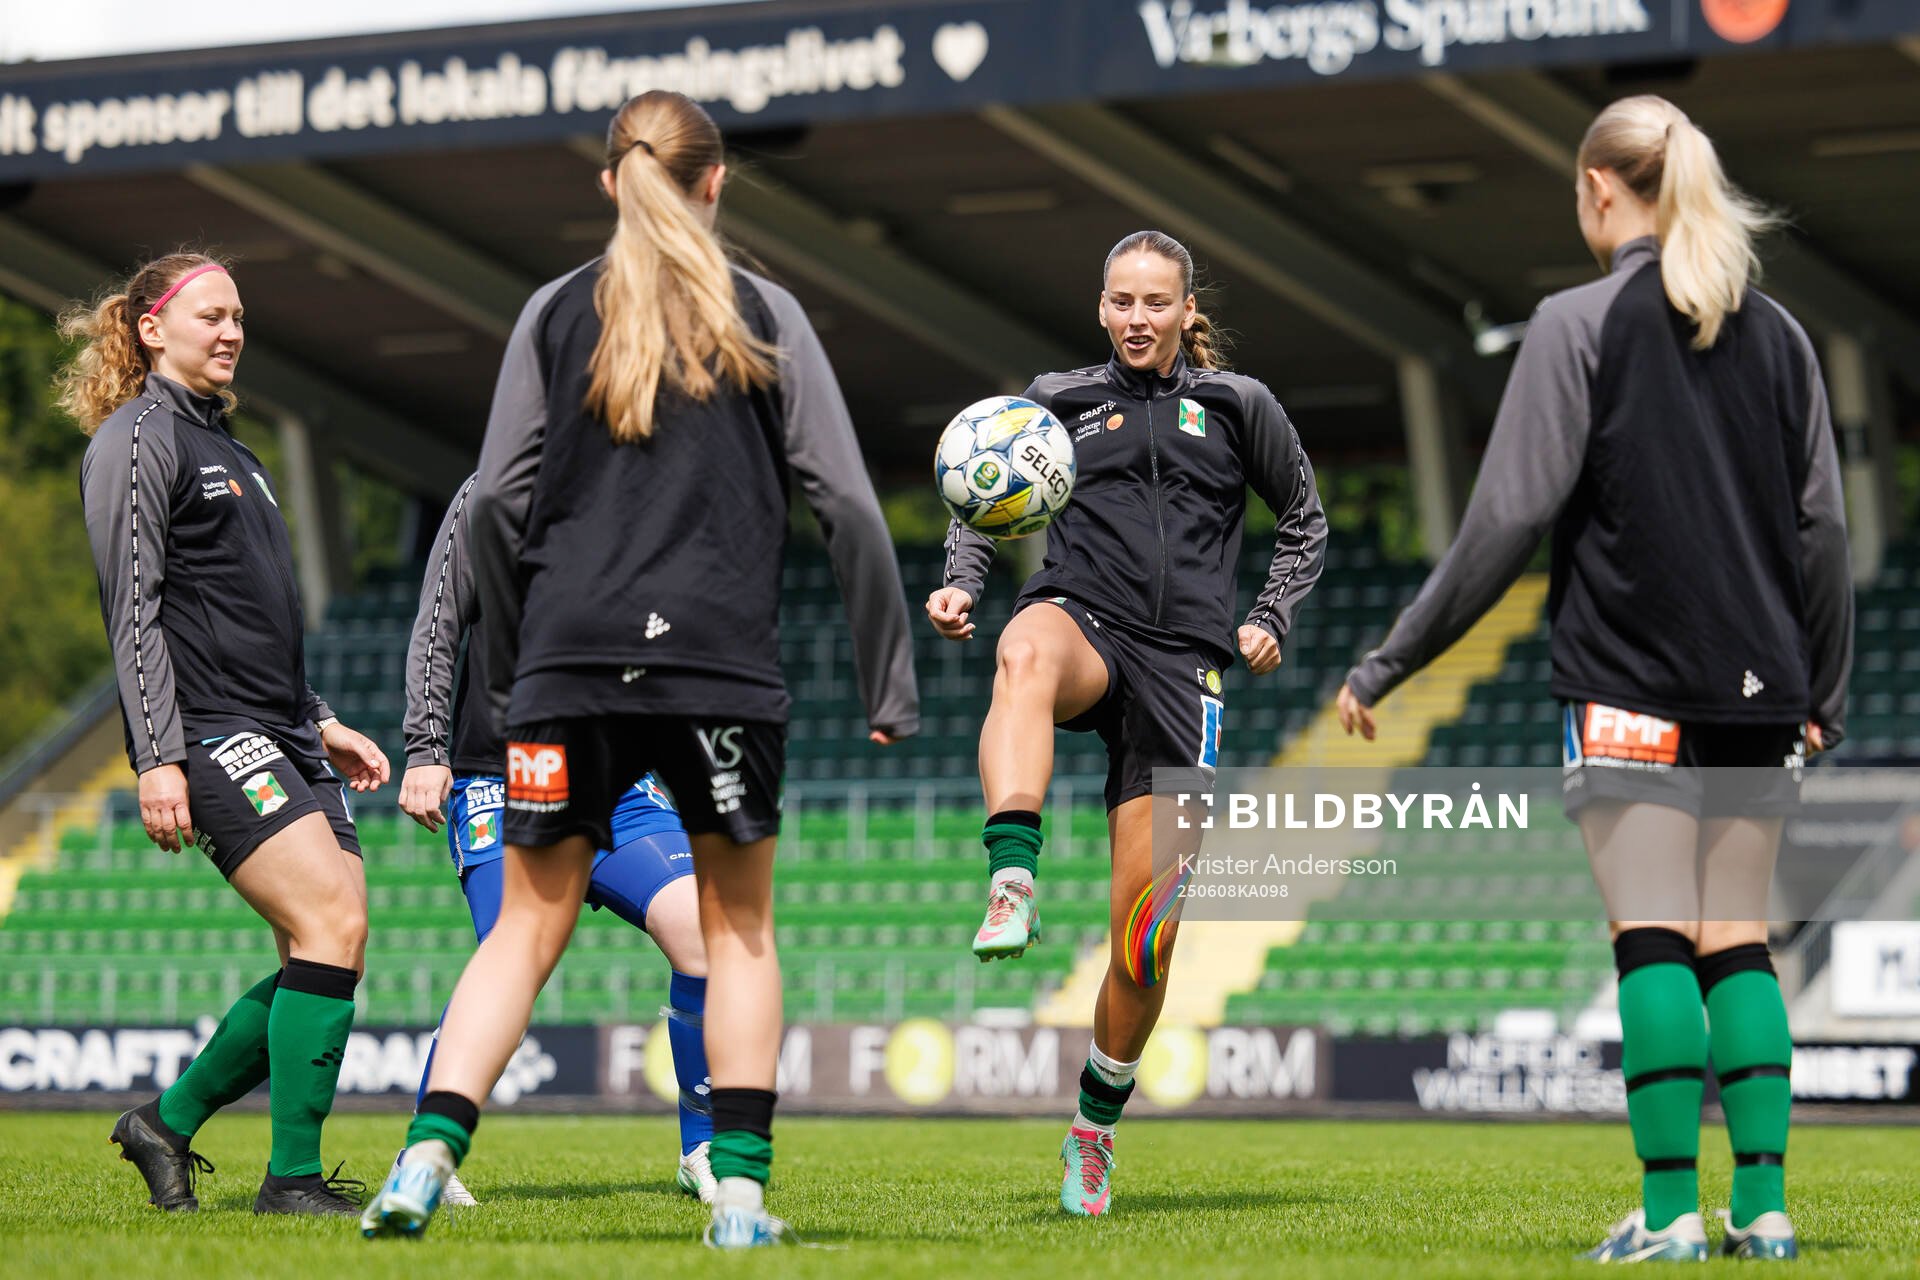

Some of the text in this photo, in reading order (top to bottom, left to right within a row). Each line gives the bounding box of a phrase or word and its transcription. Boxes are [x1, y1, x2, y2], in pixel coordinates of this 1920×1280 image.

[42, 92, 230, 164] sponsor
[234, 70, 304, 139] till
[307, 66, 397, 132] det
[400, 52, 547, 126] lokala
[551, 25, 905, 114] föreningslivet
[1080, 404, 1107, 421] CRAFT
[1020, 445, 1069, 502] SELECT
[508, 747, 564, 788] FMP
[0, 1028, 193, 1091] CRAFT
